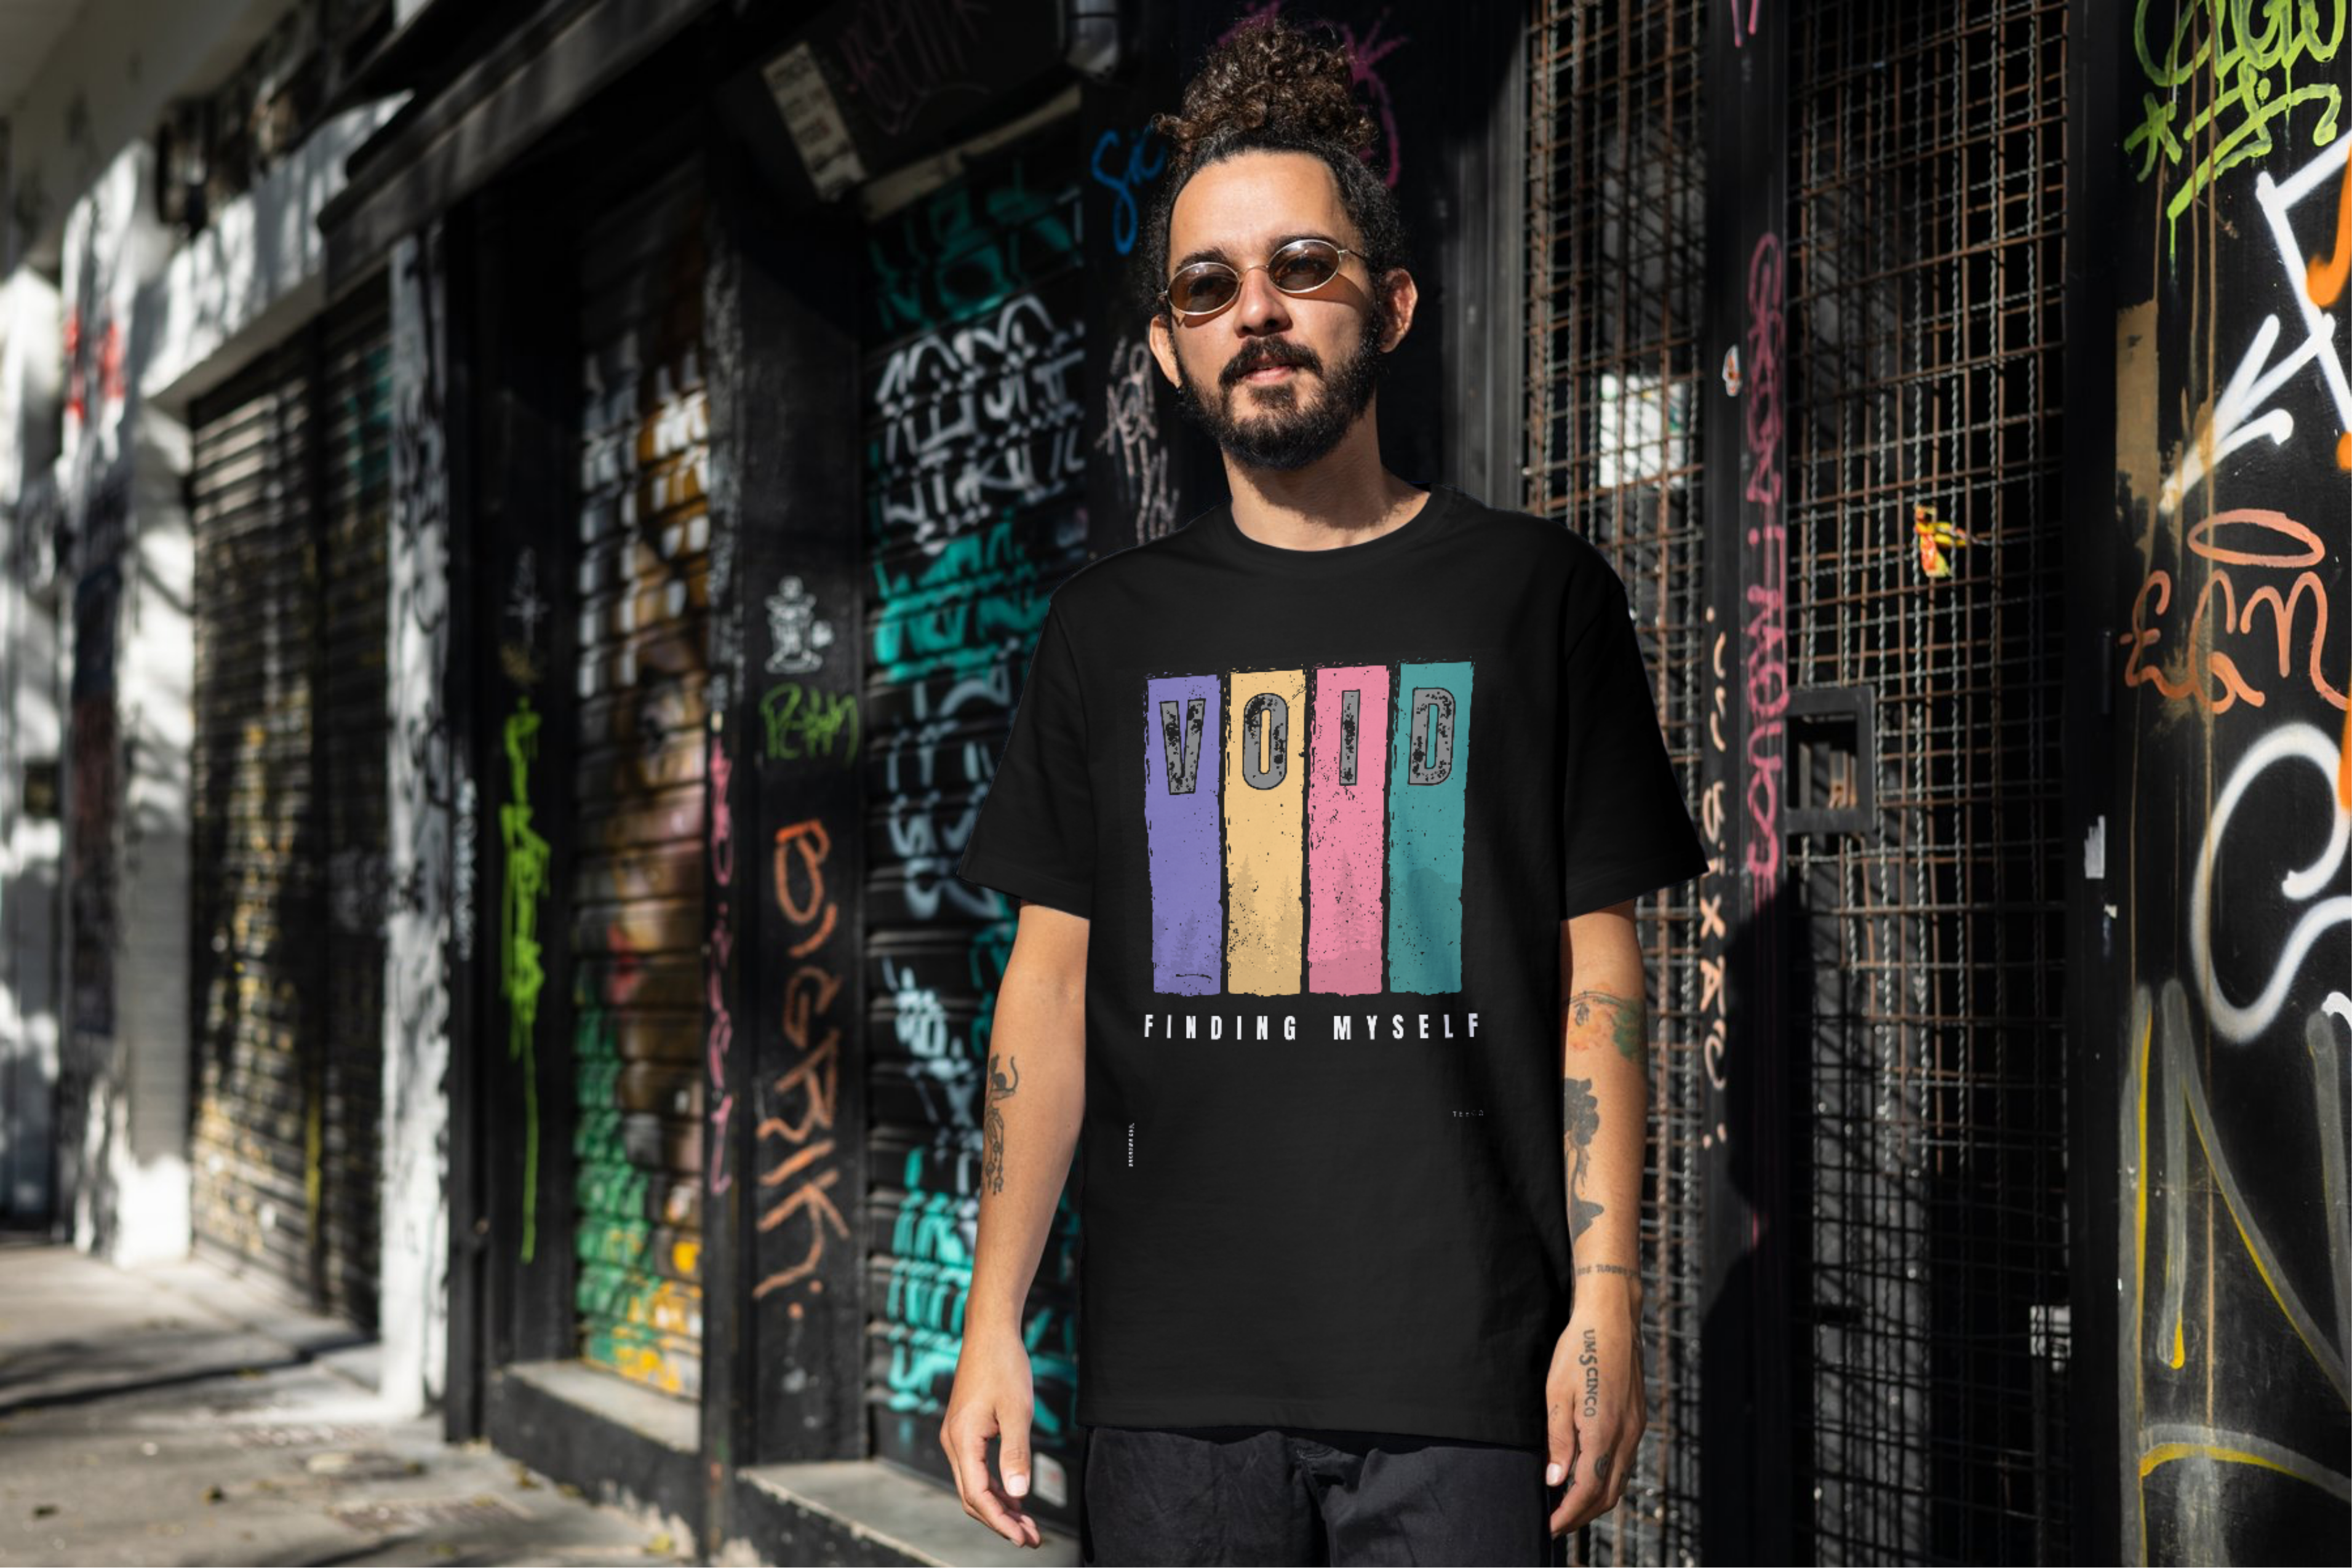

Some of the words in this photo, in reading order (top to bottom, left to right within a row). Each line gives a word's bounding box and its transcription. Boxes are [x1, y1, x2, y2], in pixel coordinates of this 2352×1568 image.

[1159, 686, 1456, 795] VOID
[1144, 1014, 1296, 1041] FINDING
[1333, 1013, 1479, 1041] MYSELF
